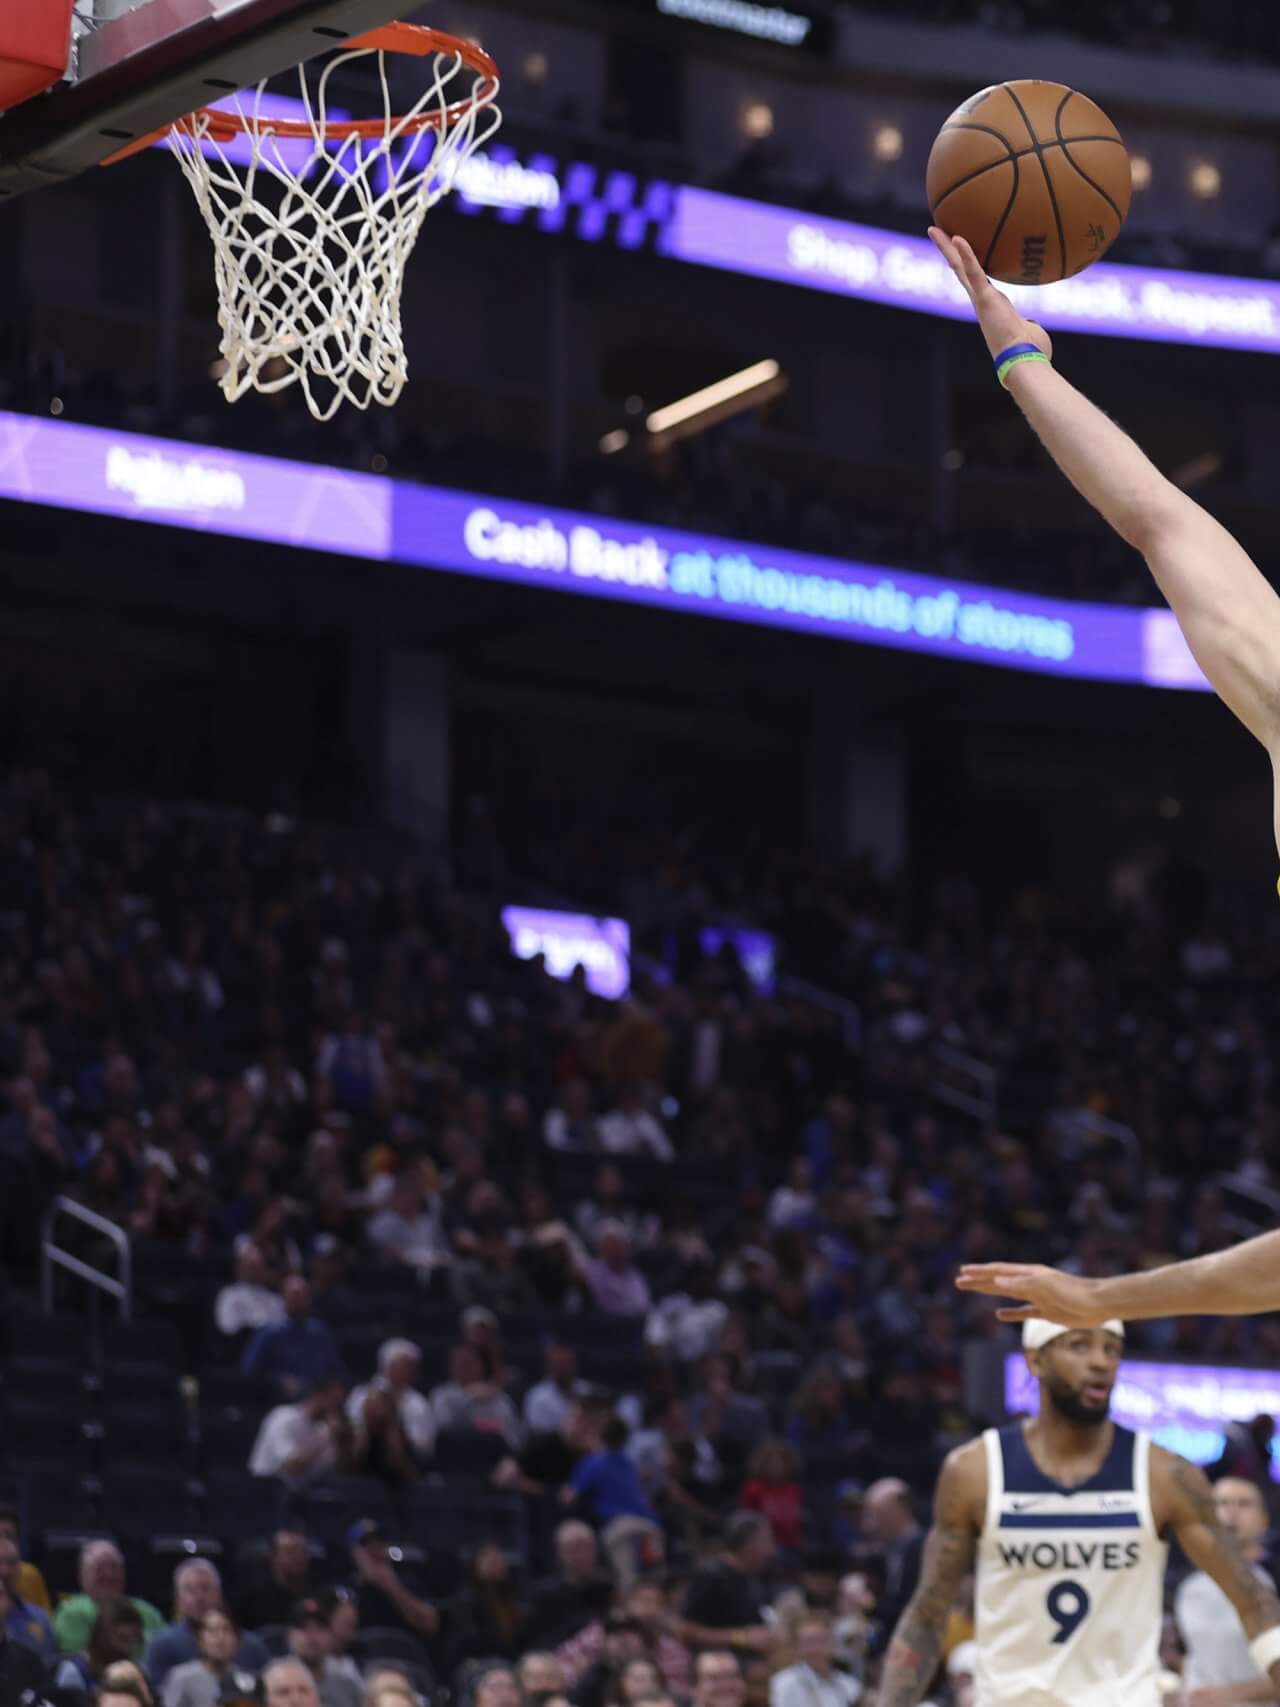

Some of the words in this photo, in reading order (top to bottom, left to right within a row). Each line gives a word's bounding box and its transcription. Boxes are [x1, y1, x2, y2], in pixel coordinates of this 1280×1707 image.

[464, 508, 568, 574] Cash
[568, 525, 668, 591] Back
[669, 550, 715, 599] at
[717, 554, 913, 633] thousands
[912, 590, 960, 638] of
[956, 600, 1075, 661] stores
[997, 1540, 1141, 1570] WOLVES
[1045, 1578, 1092, 1645] 9
